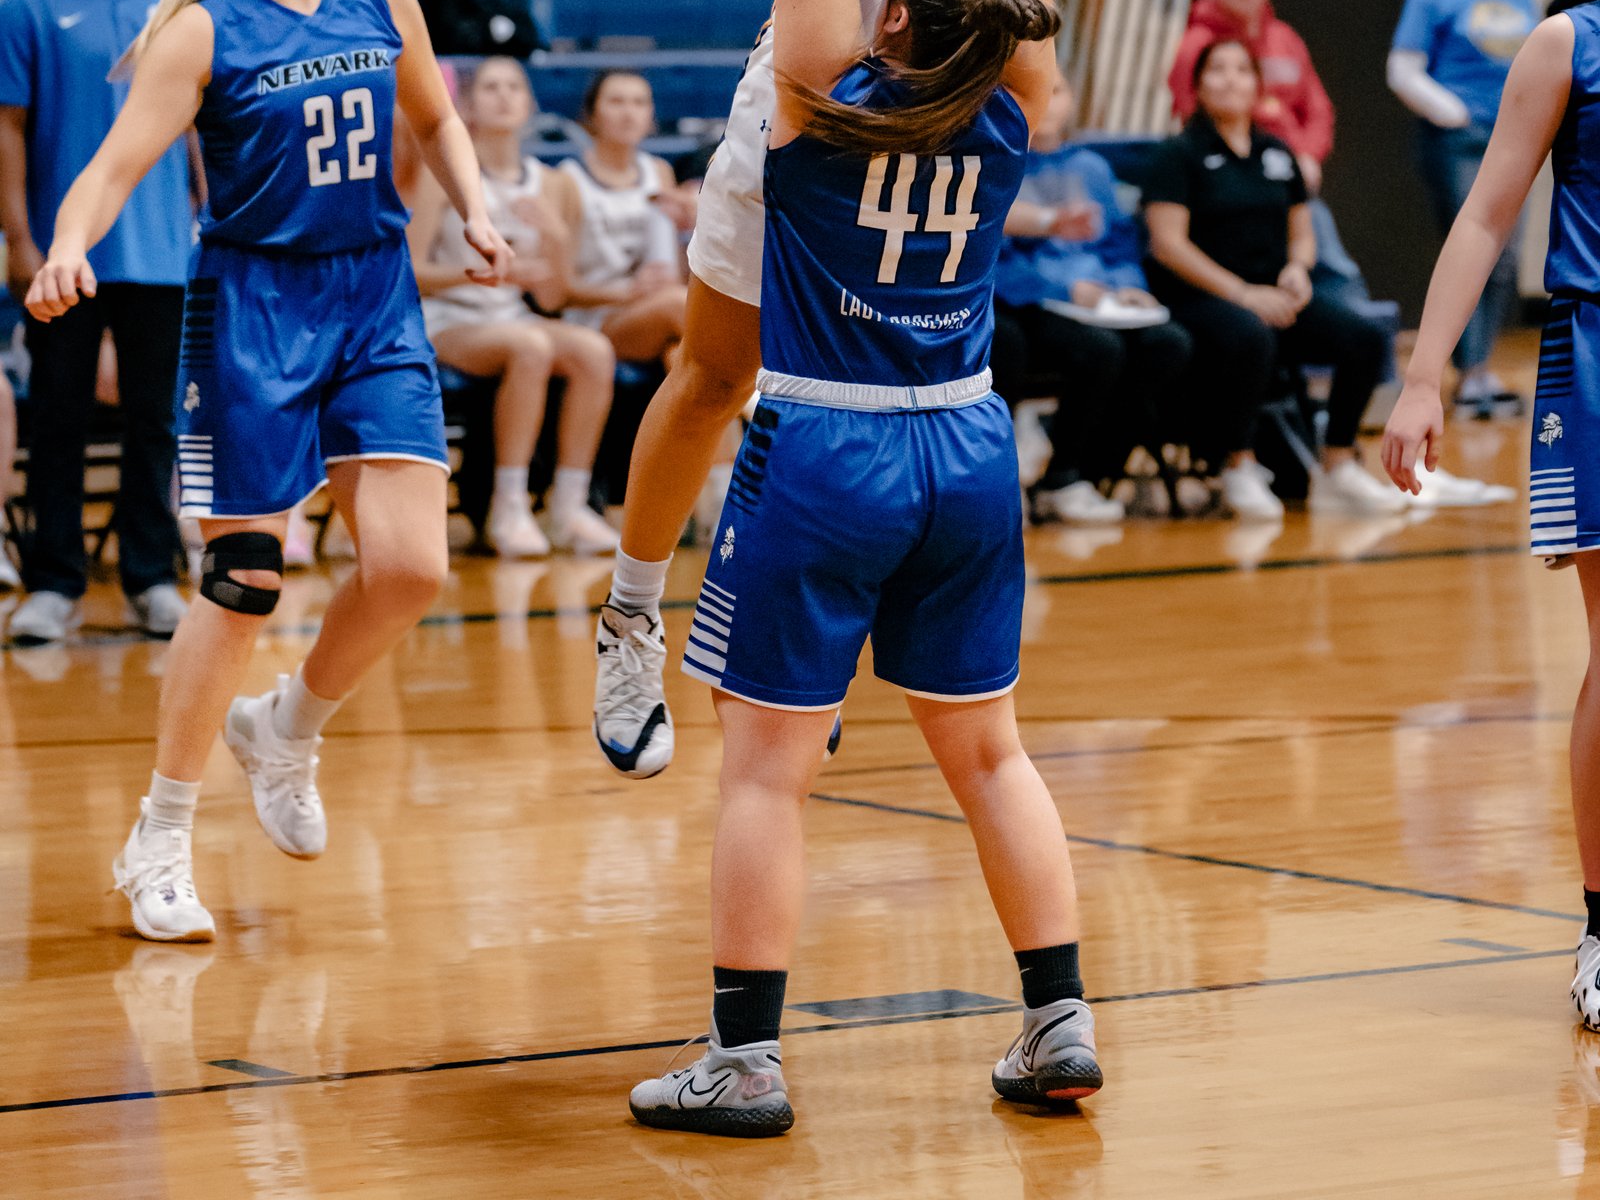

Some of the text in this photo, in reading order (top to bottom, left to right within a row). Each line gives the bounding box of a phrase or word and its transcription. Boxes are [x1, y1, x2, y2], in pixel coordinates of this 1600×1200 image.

[257, 48, 391, 96] NEWARK
[303, 87, 377, 187] 22
[857, 152, 981, 284] 44
